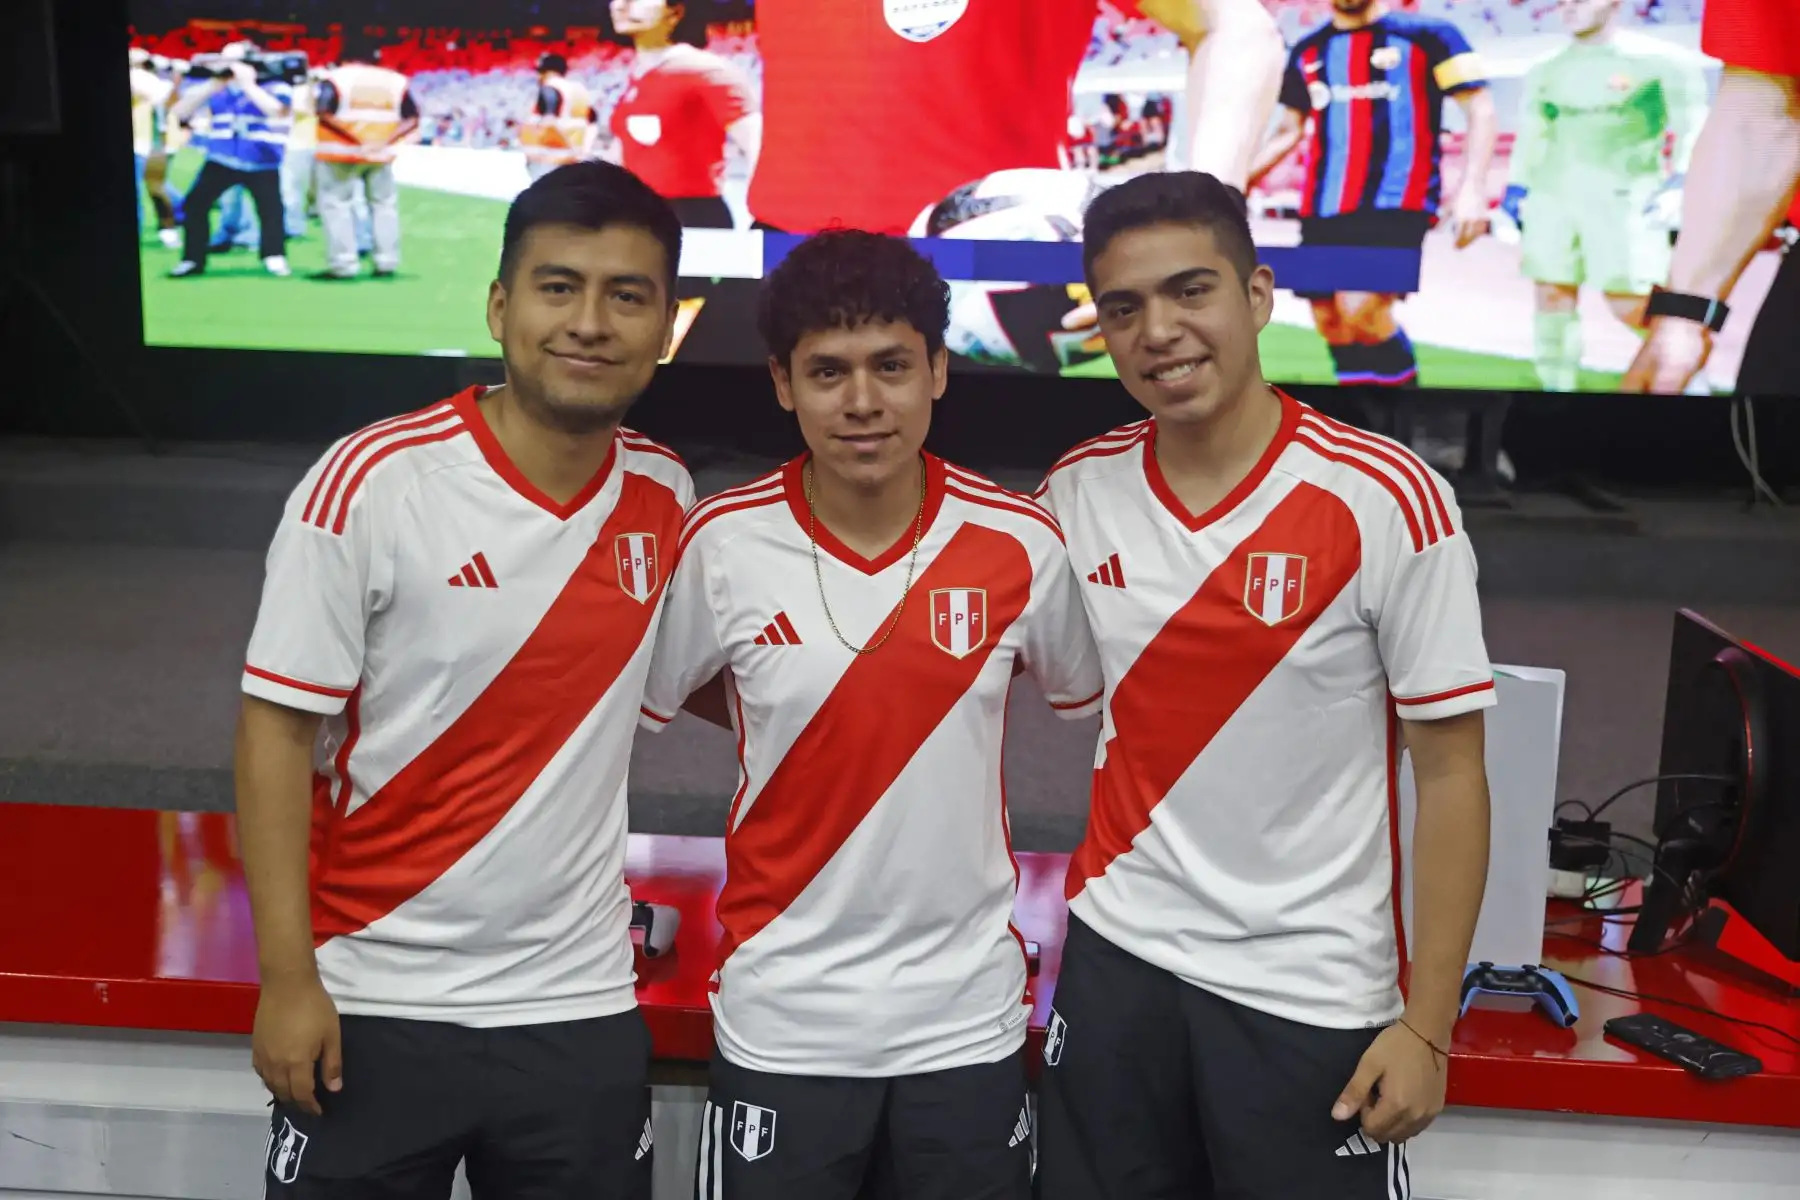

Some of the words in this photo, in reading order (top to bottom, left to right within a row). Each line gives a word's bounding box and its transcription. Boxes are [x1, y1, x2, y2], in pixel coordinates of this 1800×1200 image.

[622, 557, 653, 571] FPF
[1253, 577, 1297, 592] FPF
[938, 612, 980, 626] FPF
[737, 1120, 769, 1137] FPF
